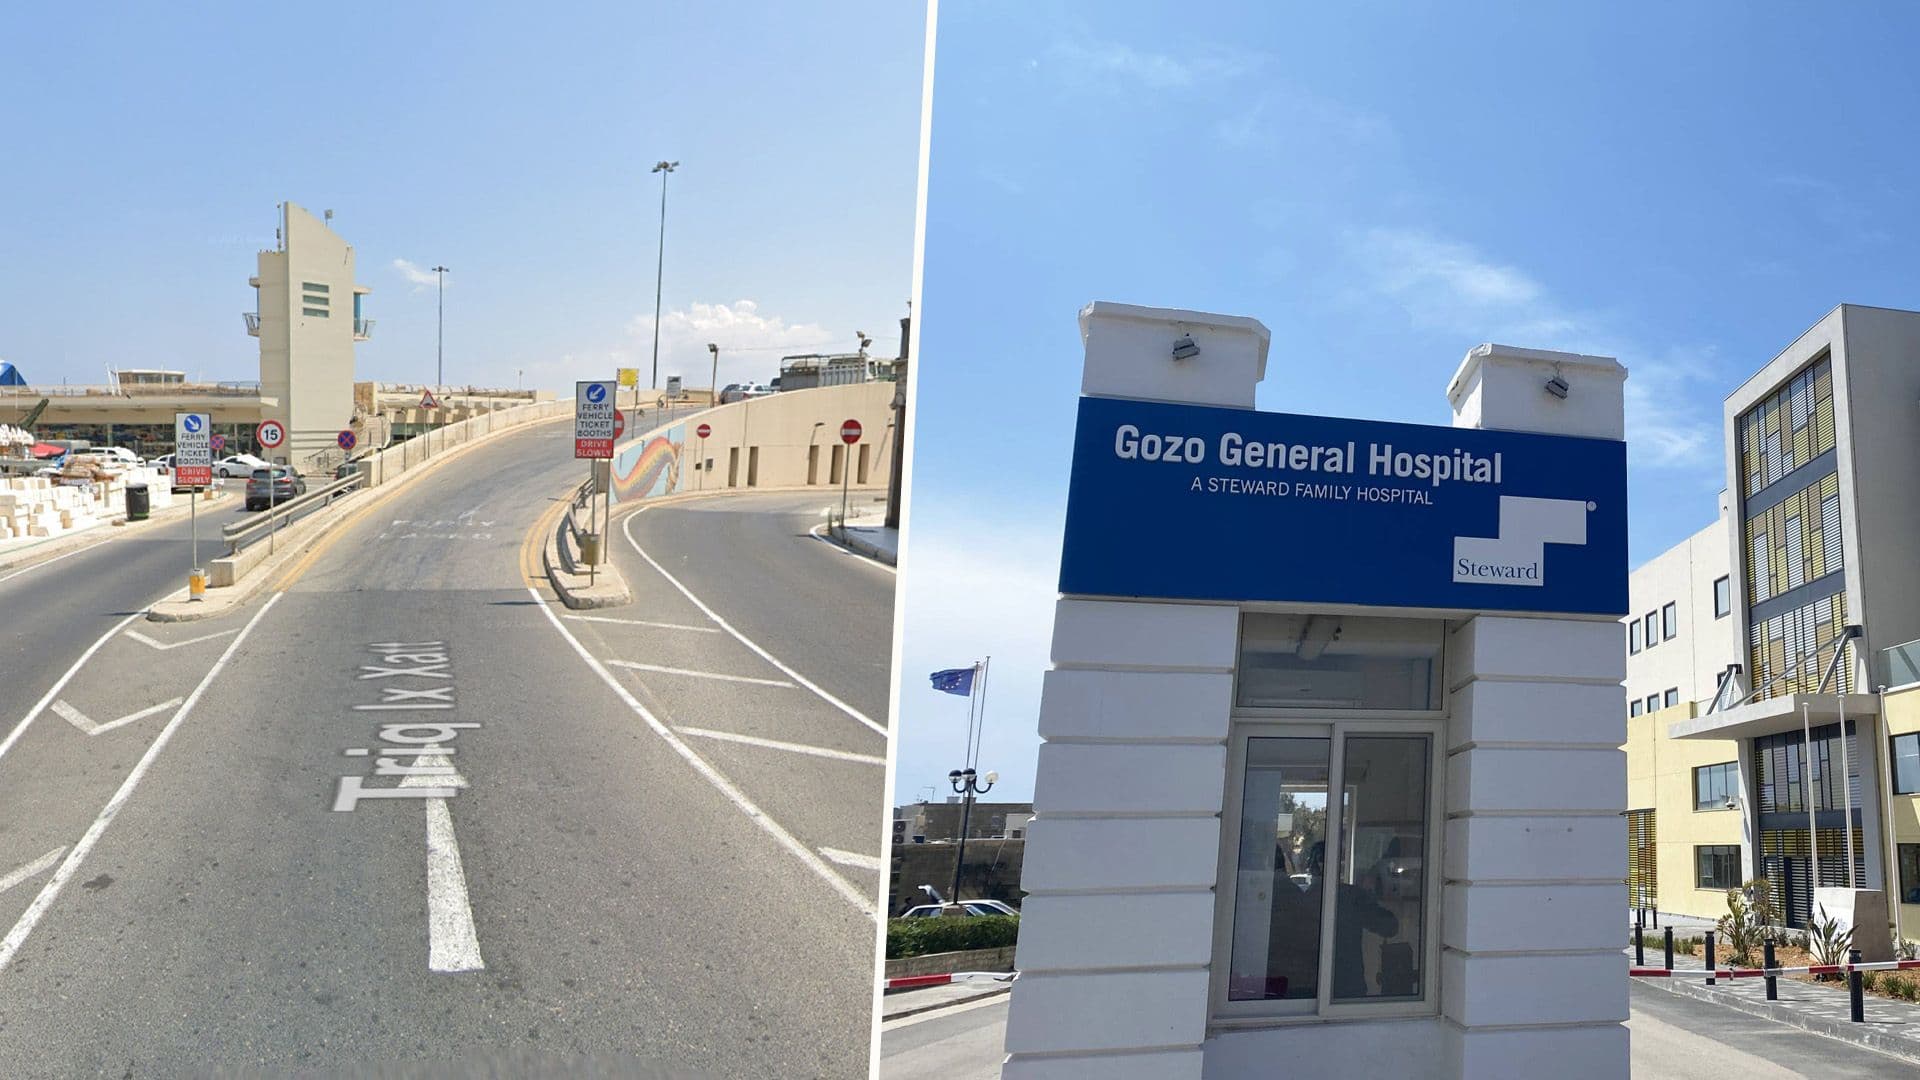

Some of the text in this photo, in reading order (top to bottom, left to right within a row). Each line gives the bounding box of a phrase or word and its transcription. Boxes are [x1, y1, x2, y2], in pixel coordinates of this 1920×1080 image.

[582, 403, 609, 411] FERRY
[577, 412, 613, 420] VEHICLE
[263, 429, 279, 441] 15
[581, 440, 608, 448] DRIVE
[576, 449, 611, 457] SLOWLY
[1114, 424, 1502, 487] Gozo General Hospital
[177, 476, 210, 484] SLOWLY
[1190, 476, 1434, 505] A STEWARD FAMILY HOSPITAL
[1457, 558, 1538, 580] Steward
